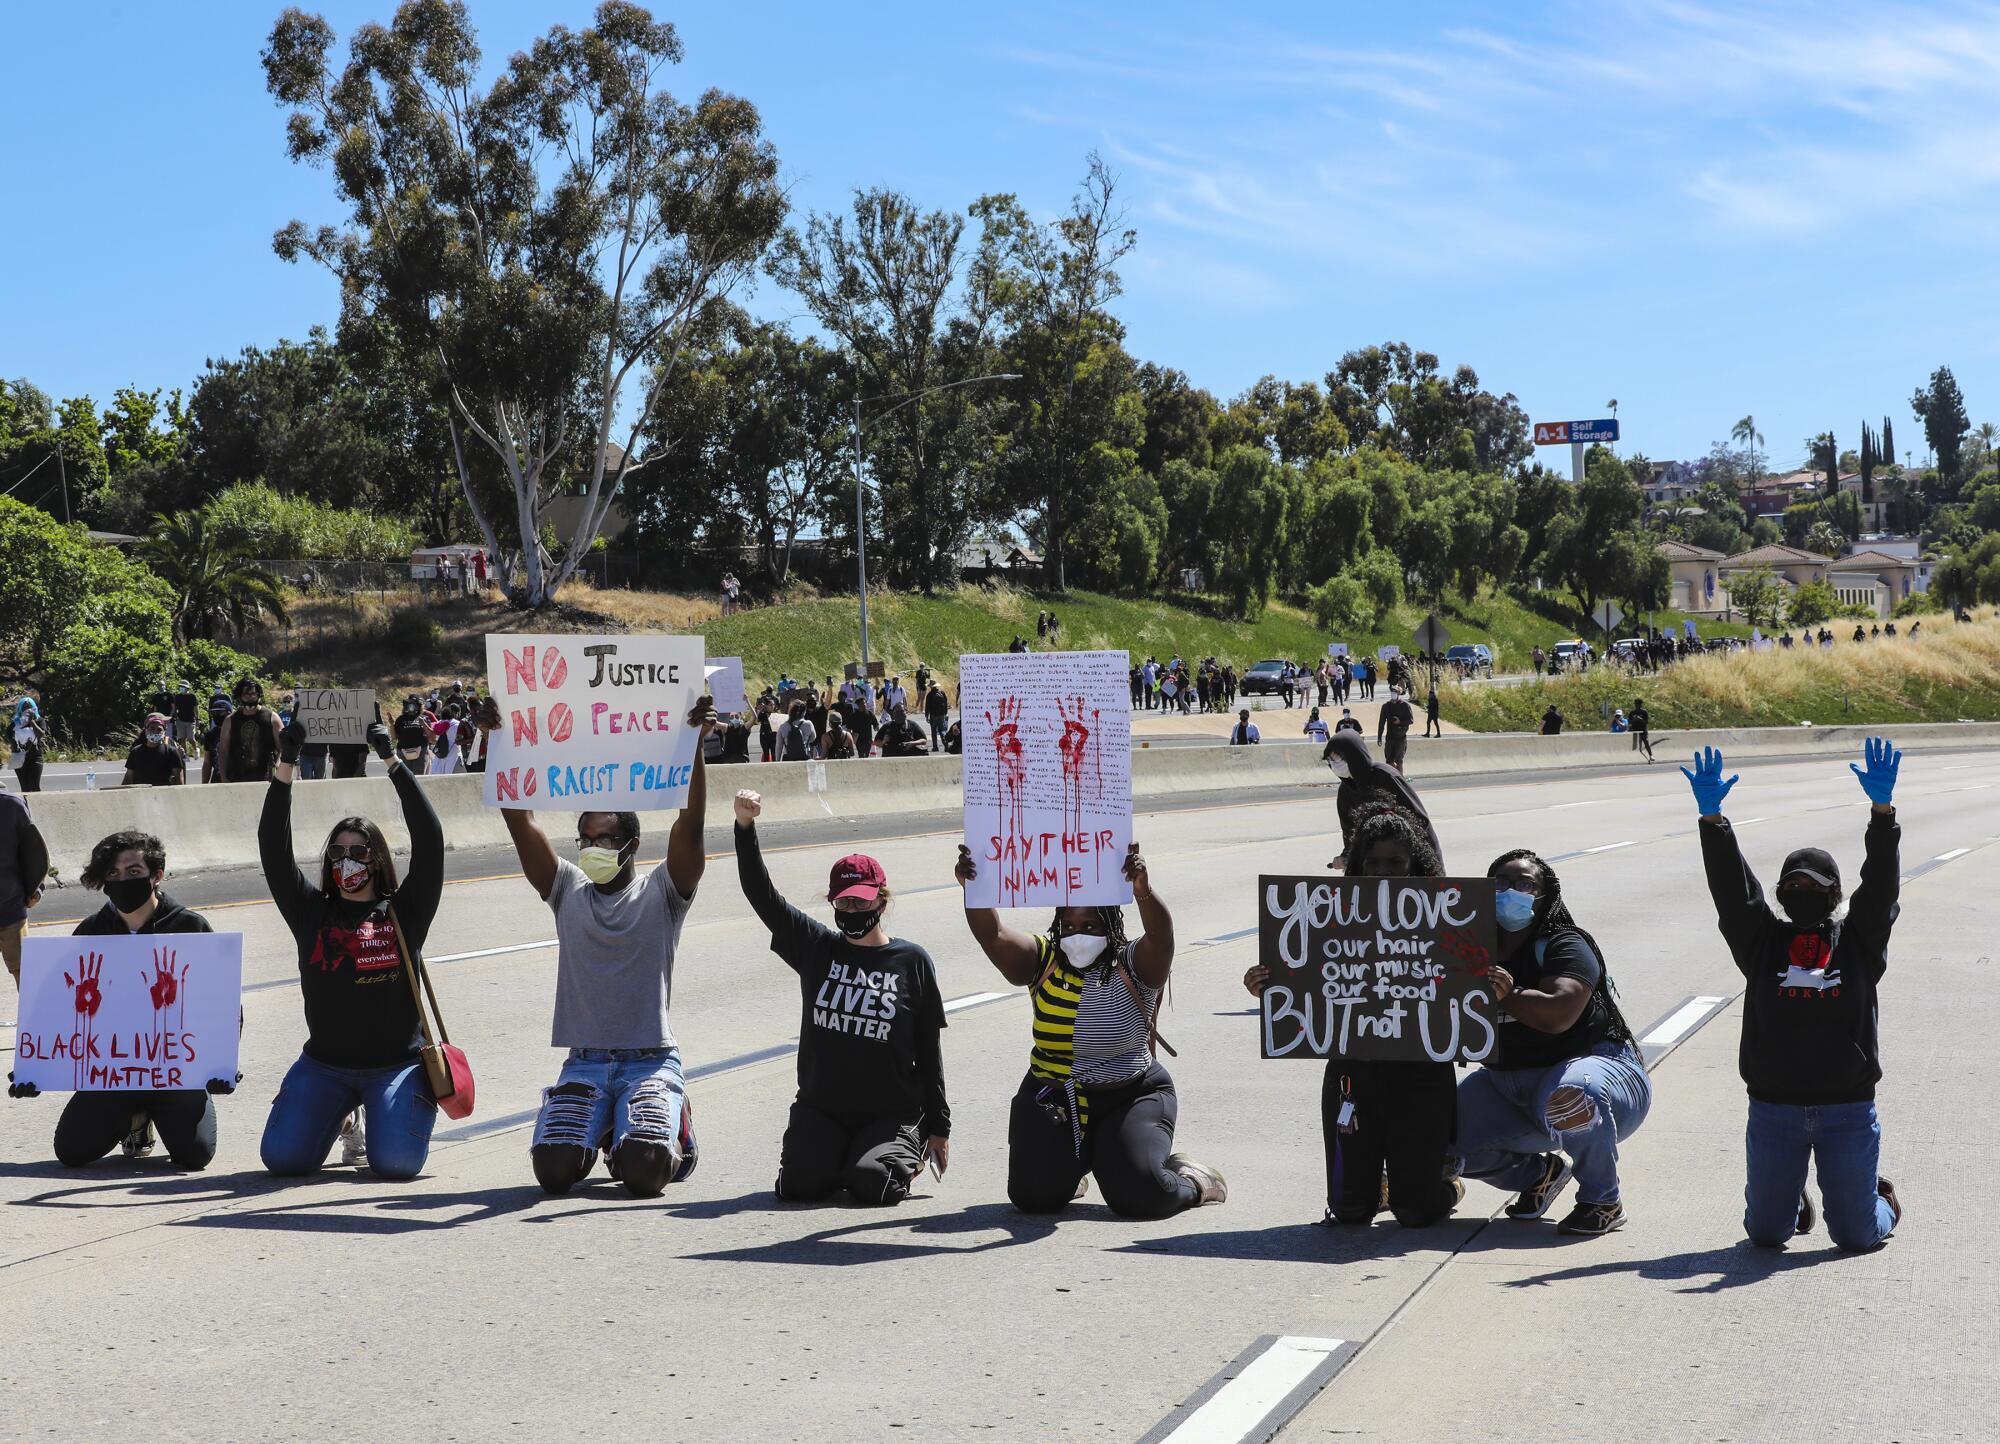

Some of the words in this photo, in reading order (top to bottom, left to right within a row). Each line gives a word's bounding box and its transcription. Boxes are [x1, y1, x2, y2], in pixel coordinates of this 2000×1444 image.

[1537, 425, 1568, 441] A-1
[1571, 421, 1594, 431] Self
[1572, 430, 1613, 441] Storage
[503, 645, 568, 695] NO
[307, 716, 363, 738] BREATH
[511, 702, 574, 748] NO
[591, 702, 669, 735] PEACE
[496, 767, 537, 802] NO
[547, 763, 619, 798] RACIST
[629, 762, 691, 792] POLICE
[985, 834, 1033, 862] SAY
[1039, 829, 1115, 857] THEIR
[1004, 866, 1084, 893] NAME
[1322, 938, 1372, 958] our
[1375, 930, 1435, 955] hair
[828, 959, 900, 992] BLACK
[1321, 960, 1371, 981] our
[1374, 957, 1447, 979] music
[815, 980, 897, 1020] LIVES
[1322, 980, 1368, 999] our
[1372, 976, 1437, 1001] food
[1777, 987, 1840, 998] TOKYO
[813, 1007, 892, 1041] MATTER
[1263, 985, 1369, 1057] BUT
[1357, 1000, 1408, 1039] not
[1417, 989, 1495, 1063] US
[19, 1032, 101, 1060] BLACK
[111, 1032, 196, 1063] LIVES
[90, 1065, 184, 1089] MATTER
